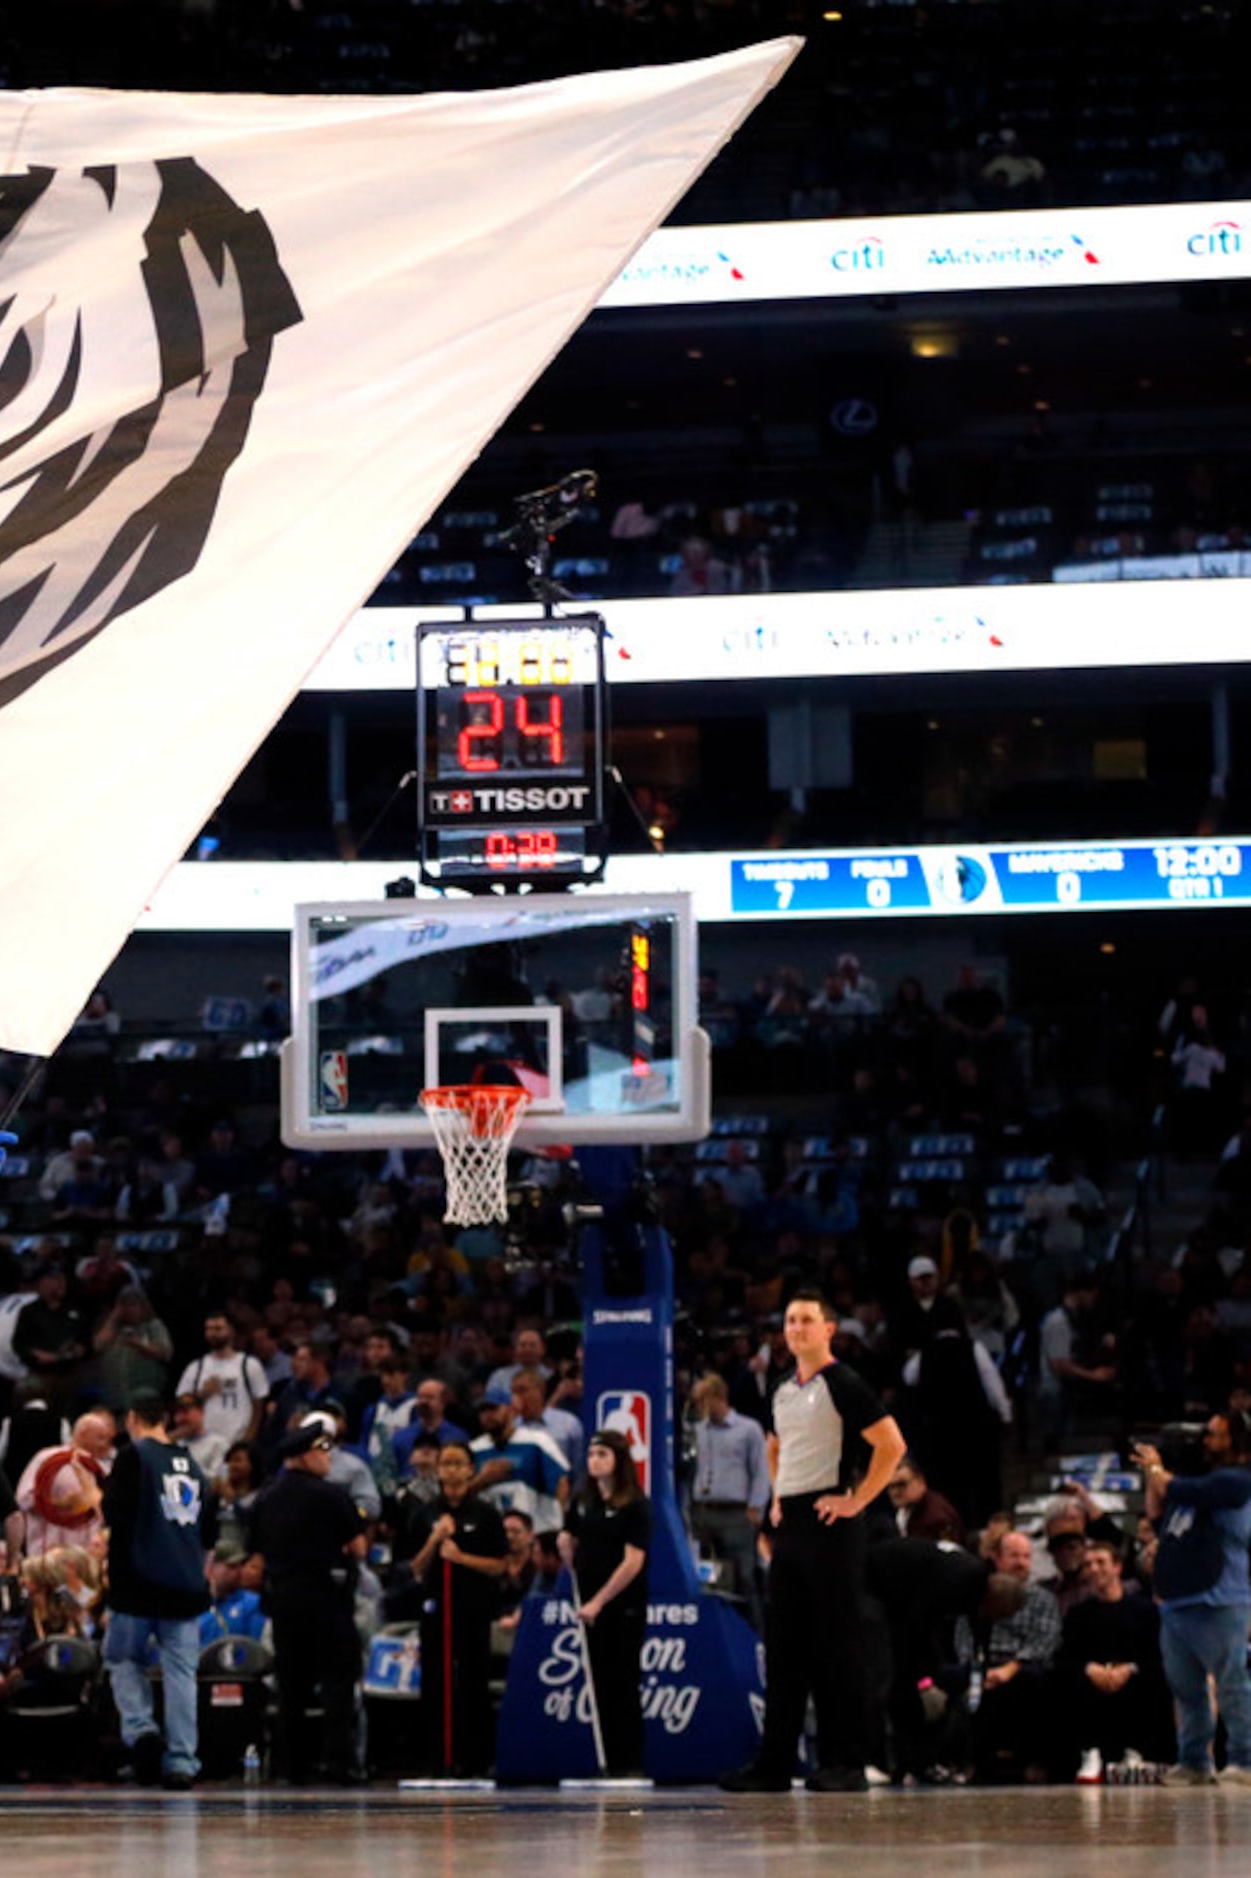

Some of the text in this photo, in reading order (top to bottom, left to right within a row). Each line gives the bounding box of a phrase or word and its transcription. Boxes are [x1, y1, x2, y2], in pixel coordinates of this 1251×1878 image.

[1186, 229, 1242, 256] citi
[830, 243, 885, 272] citi
[458, 691, 563, 772] 24
[474, 787, 590, 811] TISSOT
[1153, 846, 1241, 877] 12:00
[774, 879, 891, 909] 7 0
